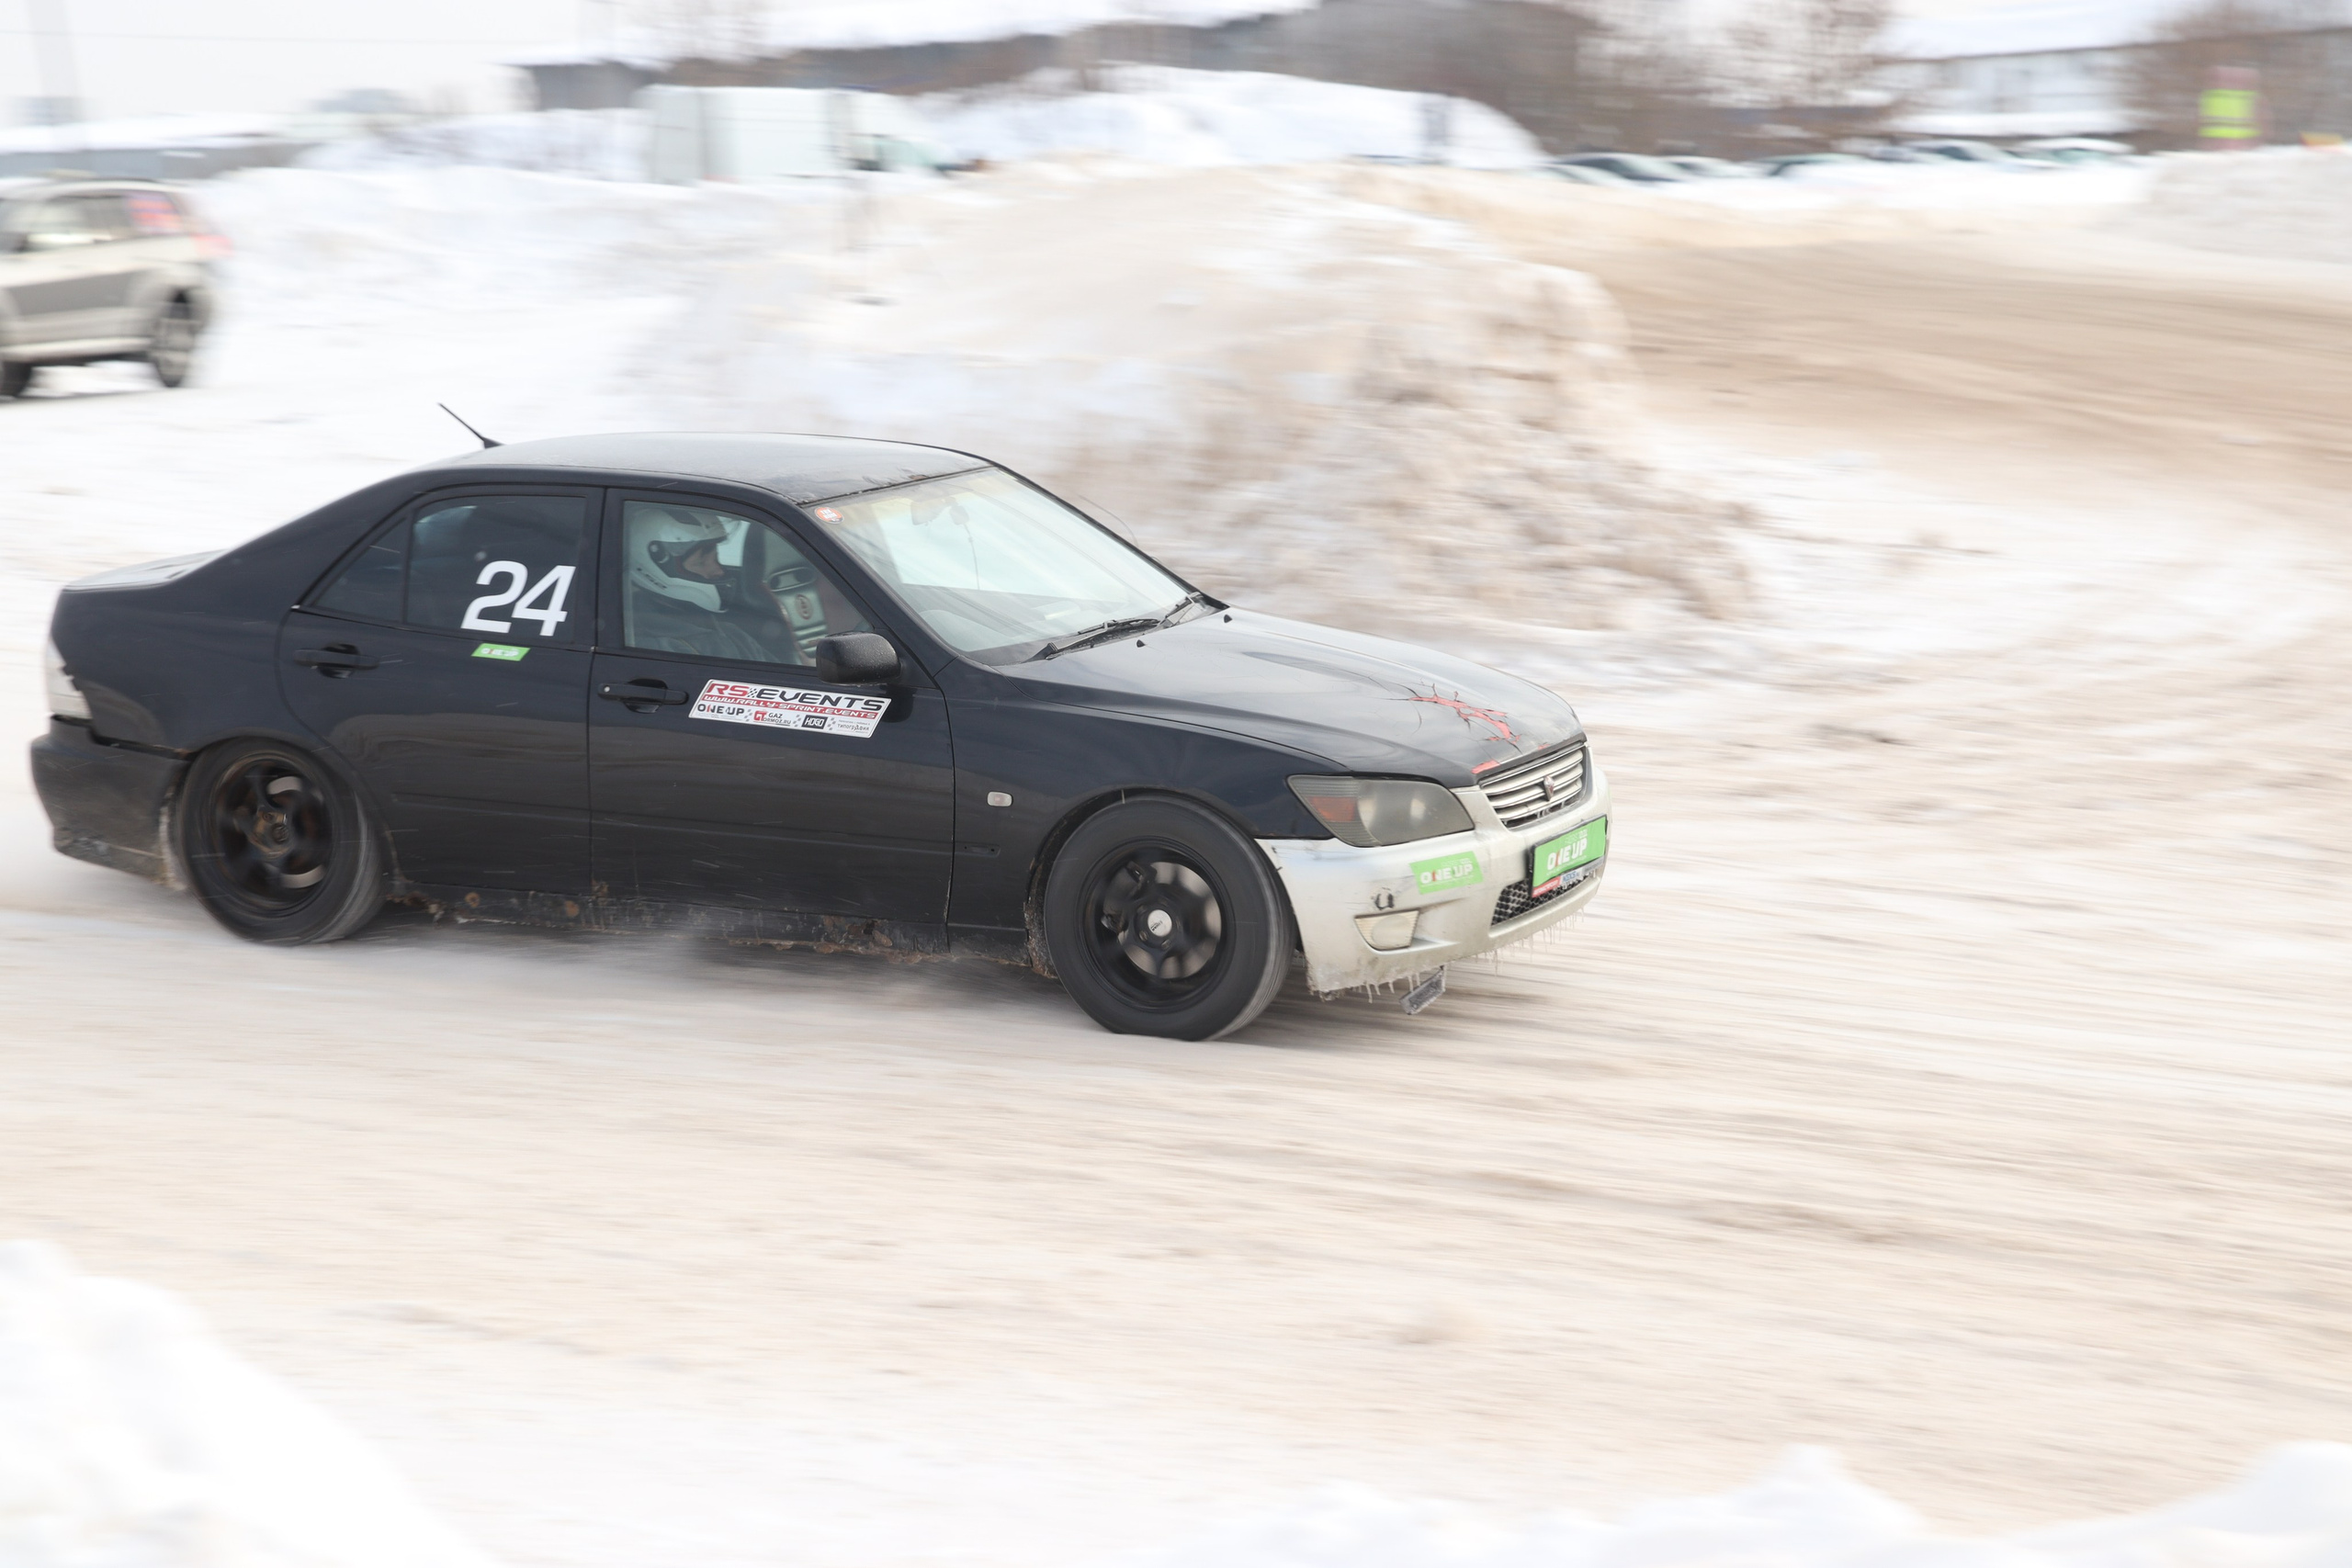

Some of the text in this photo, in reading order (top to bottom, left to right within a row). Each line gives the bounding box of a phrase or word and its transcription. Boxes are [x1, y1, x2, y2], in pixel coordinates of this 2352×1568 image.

[460, 560, 576, 637] 24
[707, 683, 885, 711] RS EVENTS
[697, 704, 744, 716] ONE UP
[1571, 838, 1588, 859] UP
[1453, 863, 1474, 878] UP
